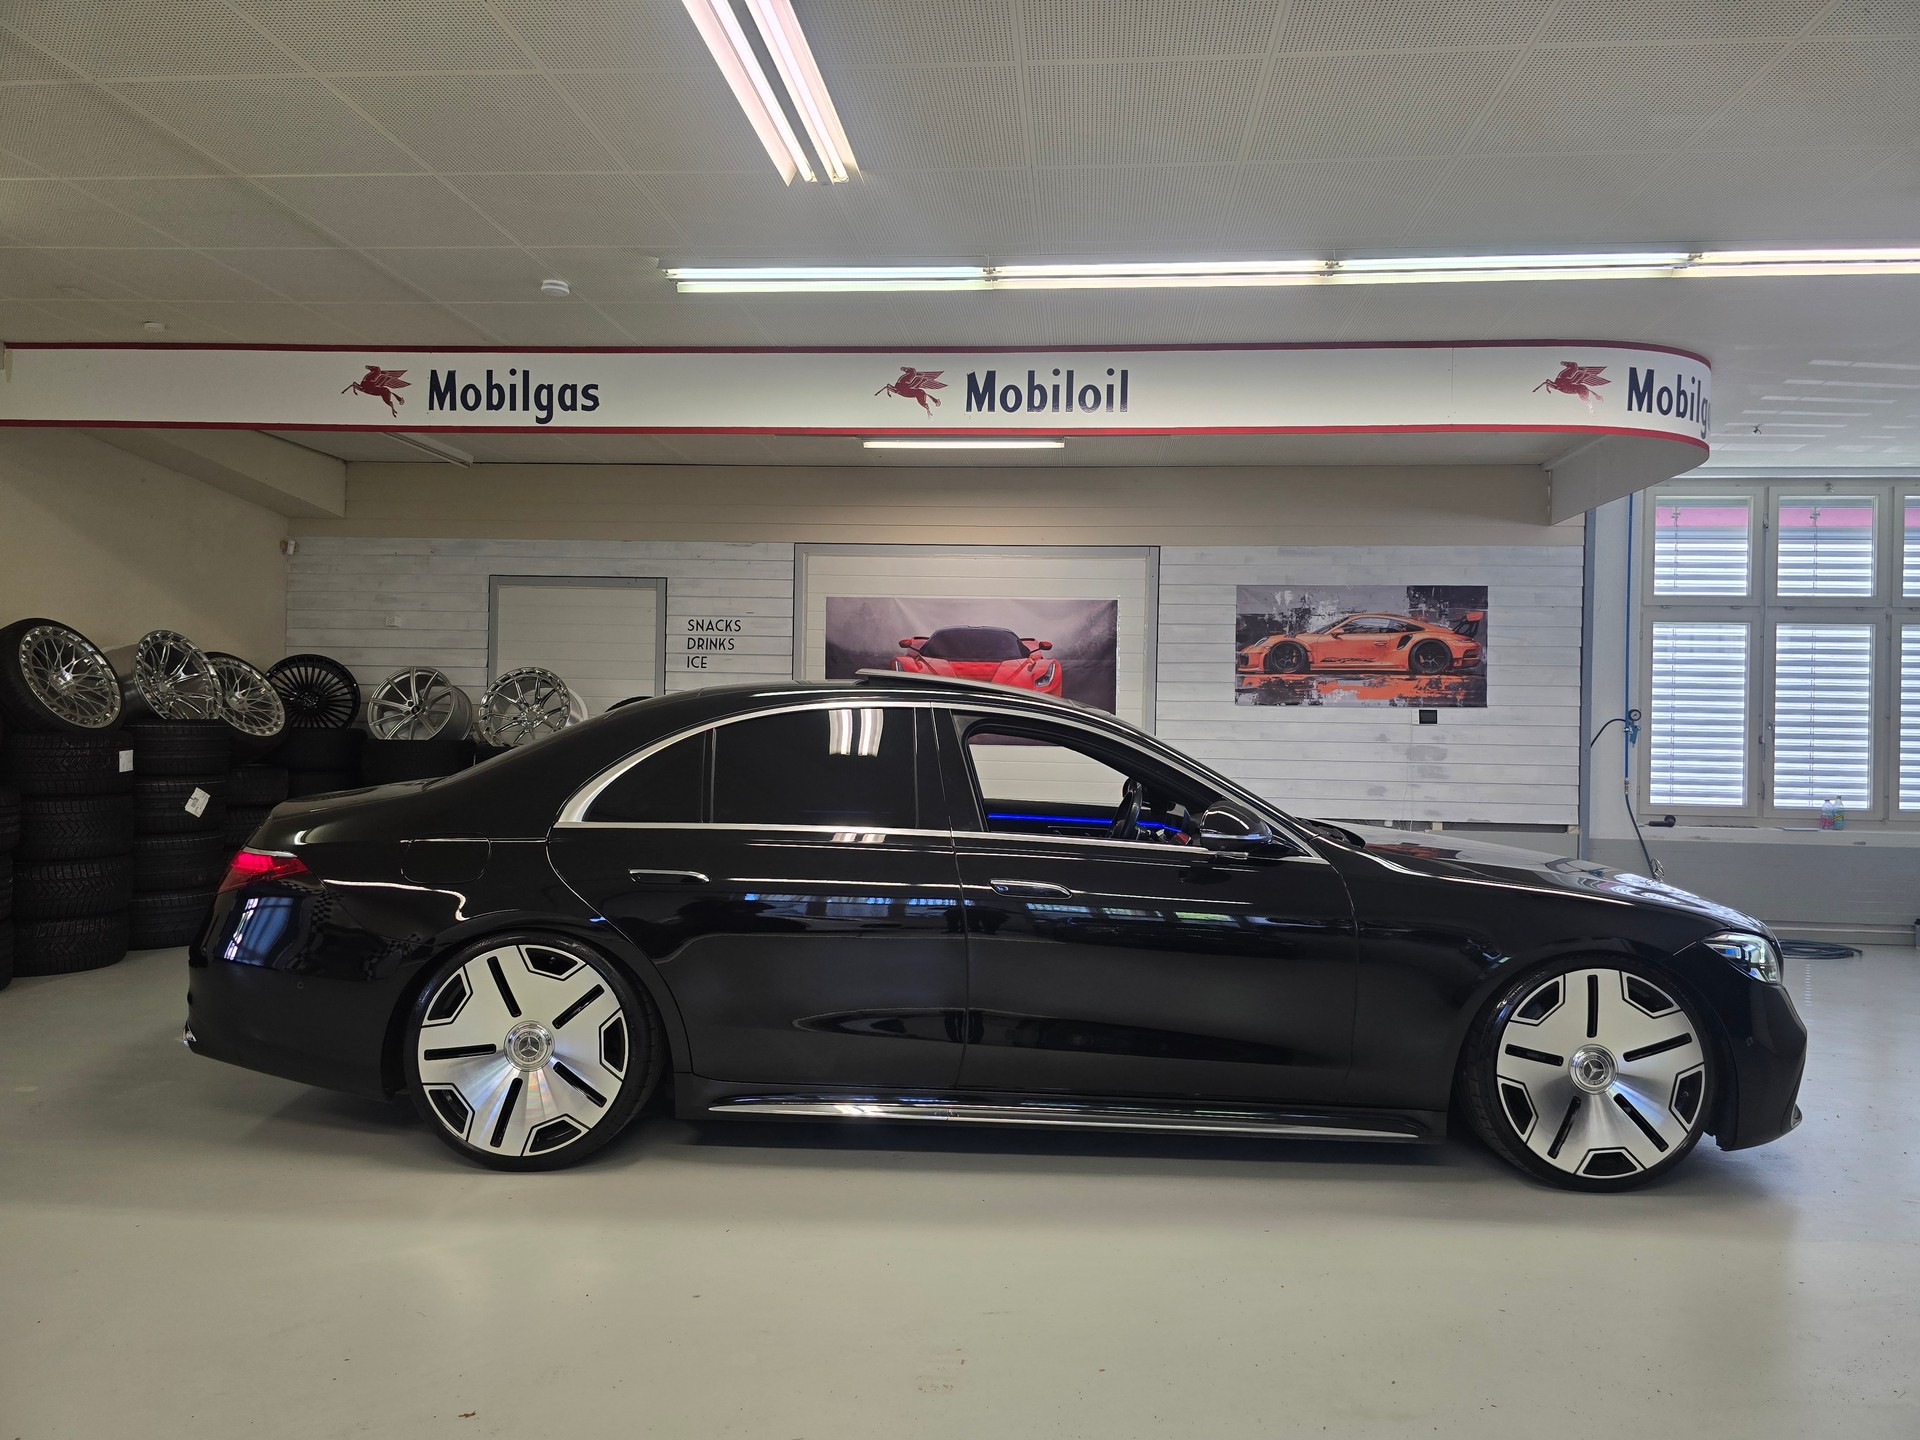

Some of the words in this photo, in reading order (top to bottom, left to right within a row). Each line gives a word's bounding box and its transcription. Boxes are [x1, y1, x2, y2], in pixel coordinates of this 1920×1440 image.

[428, 368, 600, 425] Mobilgas
[965, 367, 1129, 413] Mobiloil
[687, 618, 742, 633] SNACKS
[686, 637, 735, 651] DRINKS
[686, 655, 708, 669] ICE
